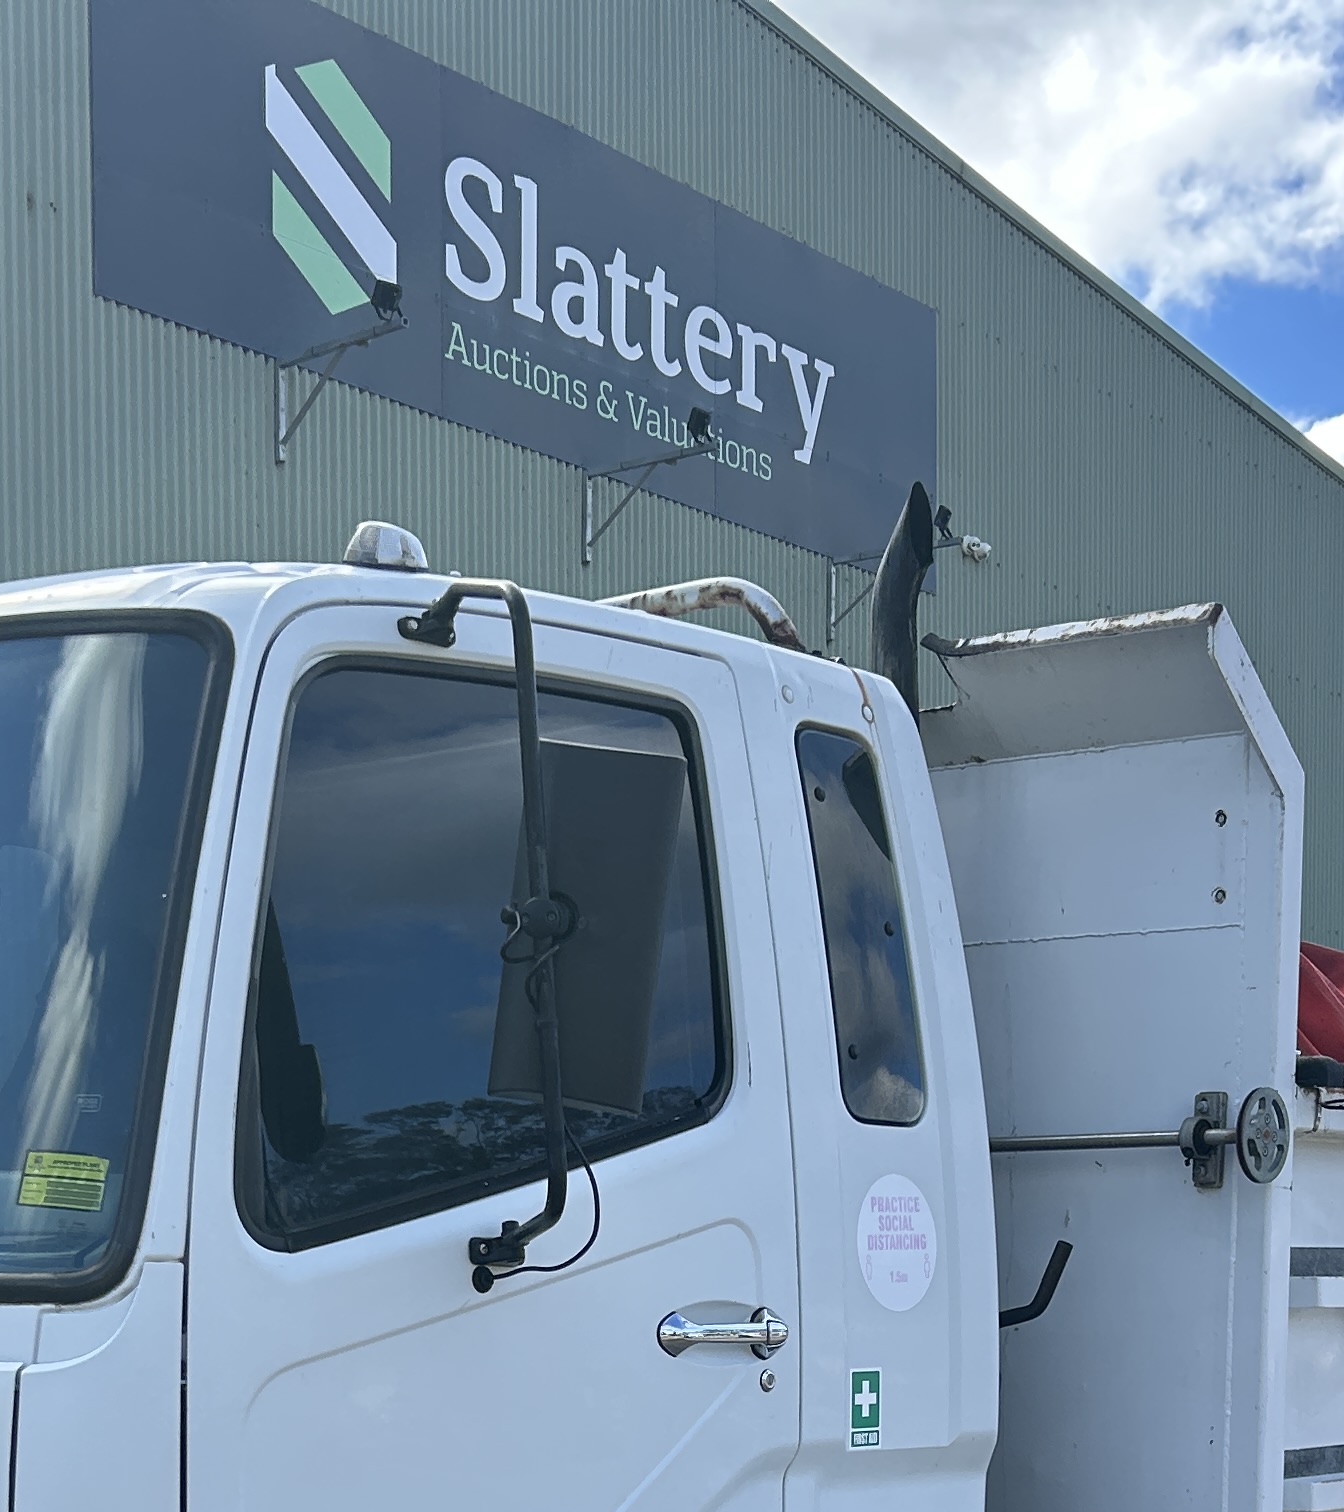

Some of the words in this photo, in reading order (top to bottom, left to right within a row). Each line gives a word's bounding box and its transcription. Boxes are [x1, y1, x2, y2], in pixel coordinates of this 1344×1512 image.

[444, 157, 835, 465] Slattery
[444, 321, 588, 410] Auctions
[596, 380, 619, 422] &
[625, 390, 772, 481] Valuions
[870, 1196, 921, 1213] PRACTICE
[878, 1215, 914, 1231] SOCIAL
[867, 1234, 927, 1250] DISTANCING
